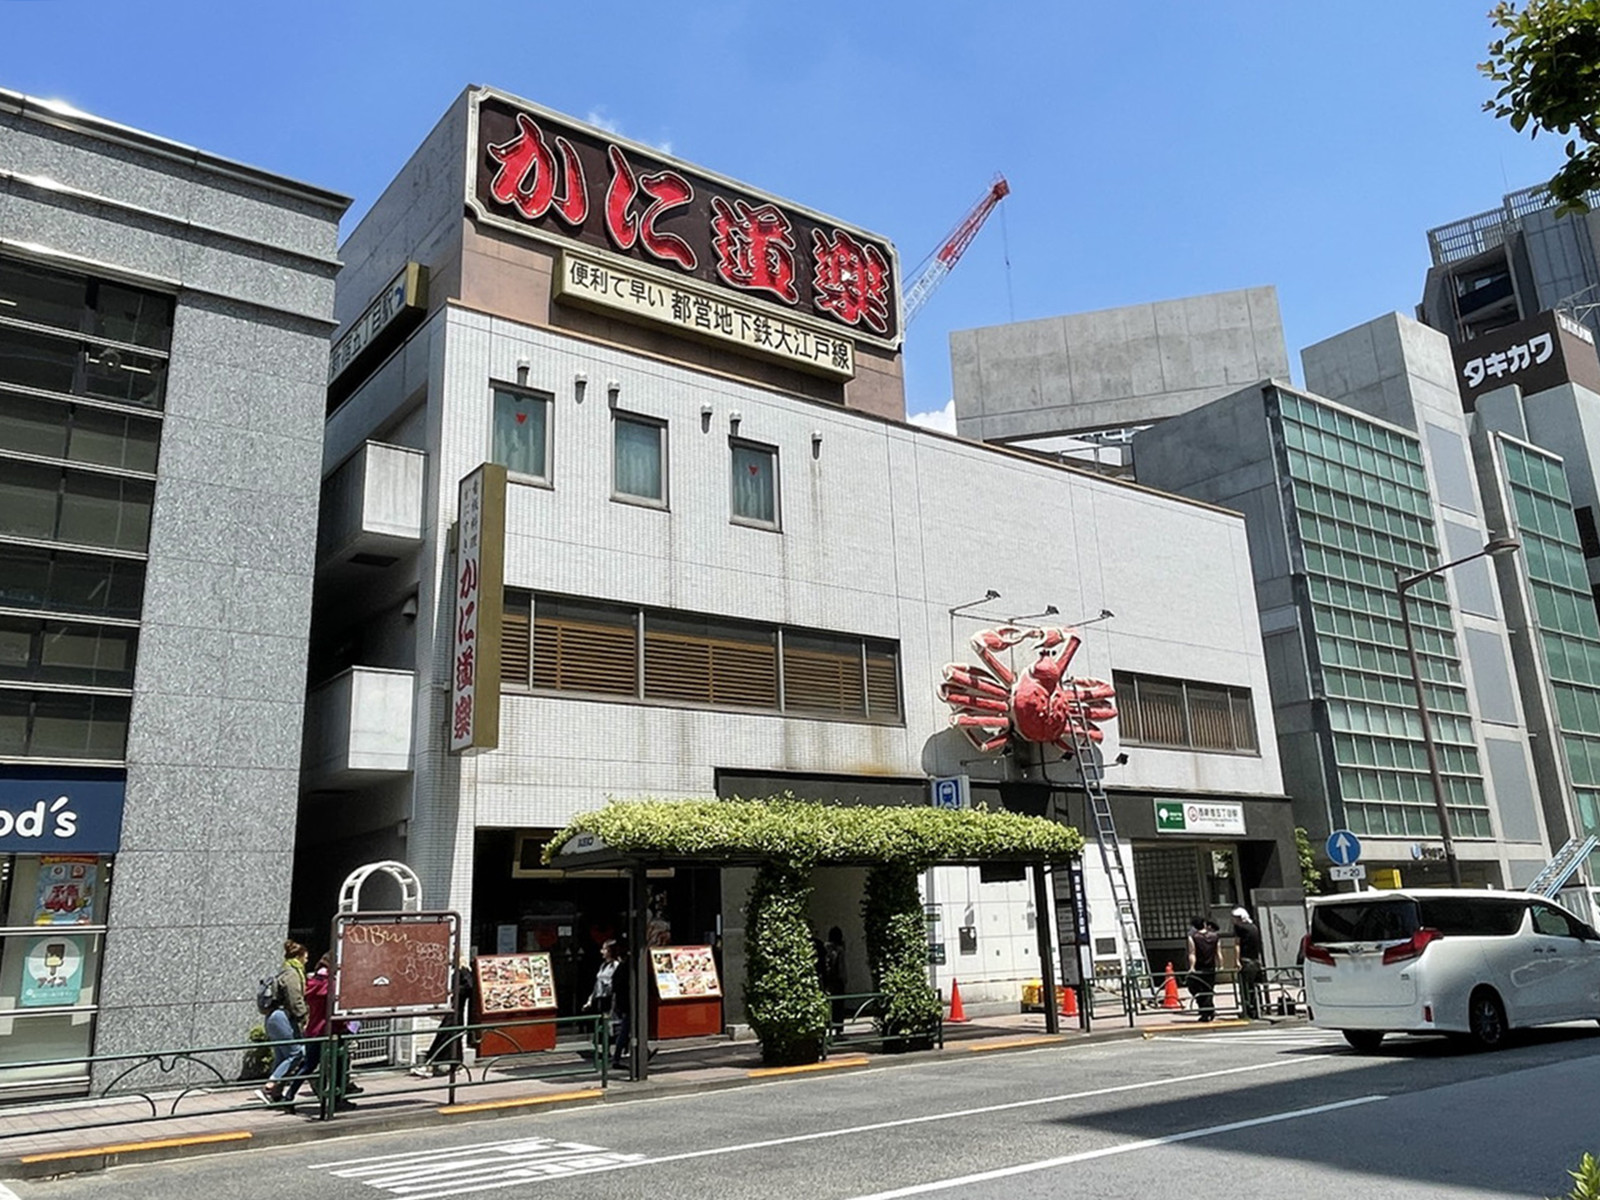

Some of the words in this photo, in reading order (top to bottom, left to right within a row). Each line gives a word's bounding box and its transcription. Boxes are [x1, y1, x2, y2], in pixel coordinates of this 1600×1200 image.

[672, 290, 850, 370] 都営地下鉄大江戸線
[1463, 332, 1554, 388] タキカワ
